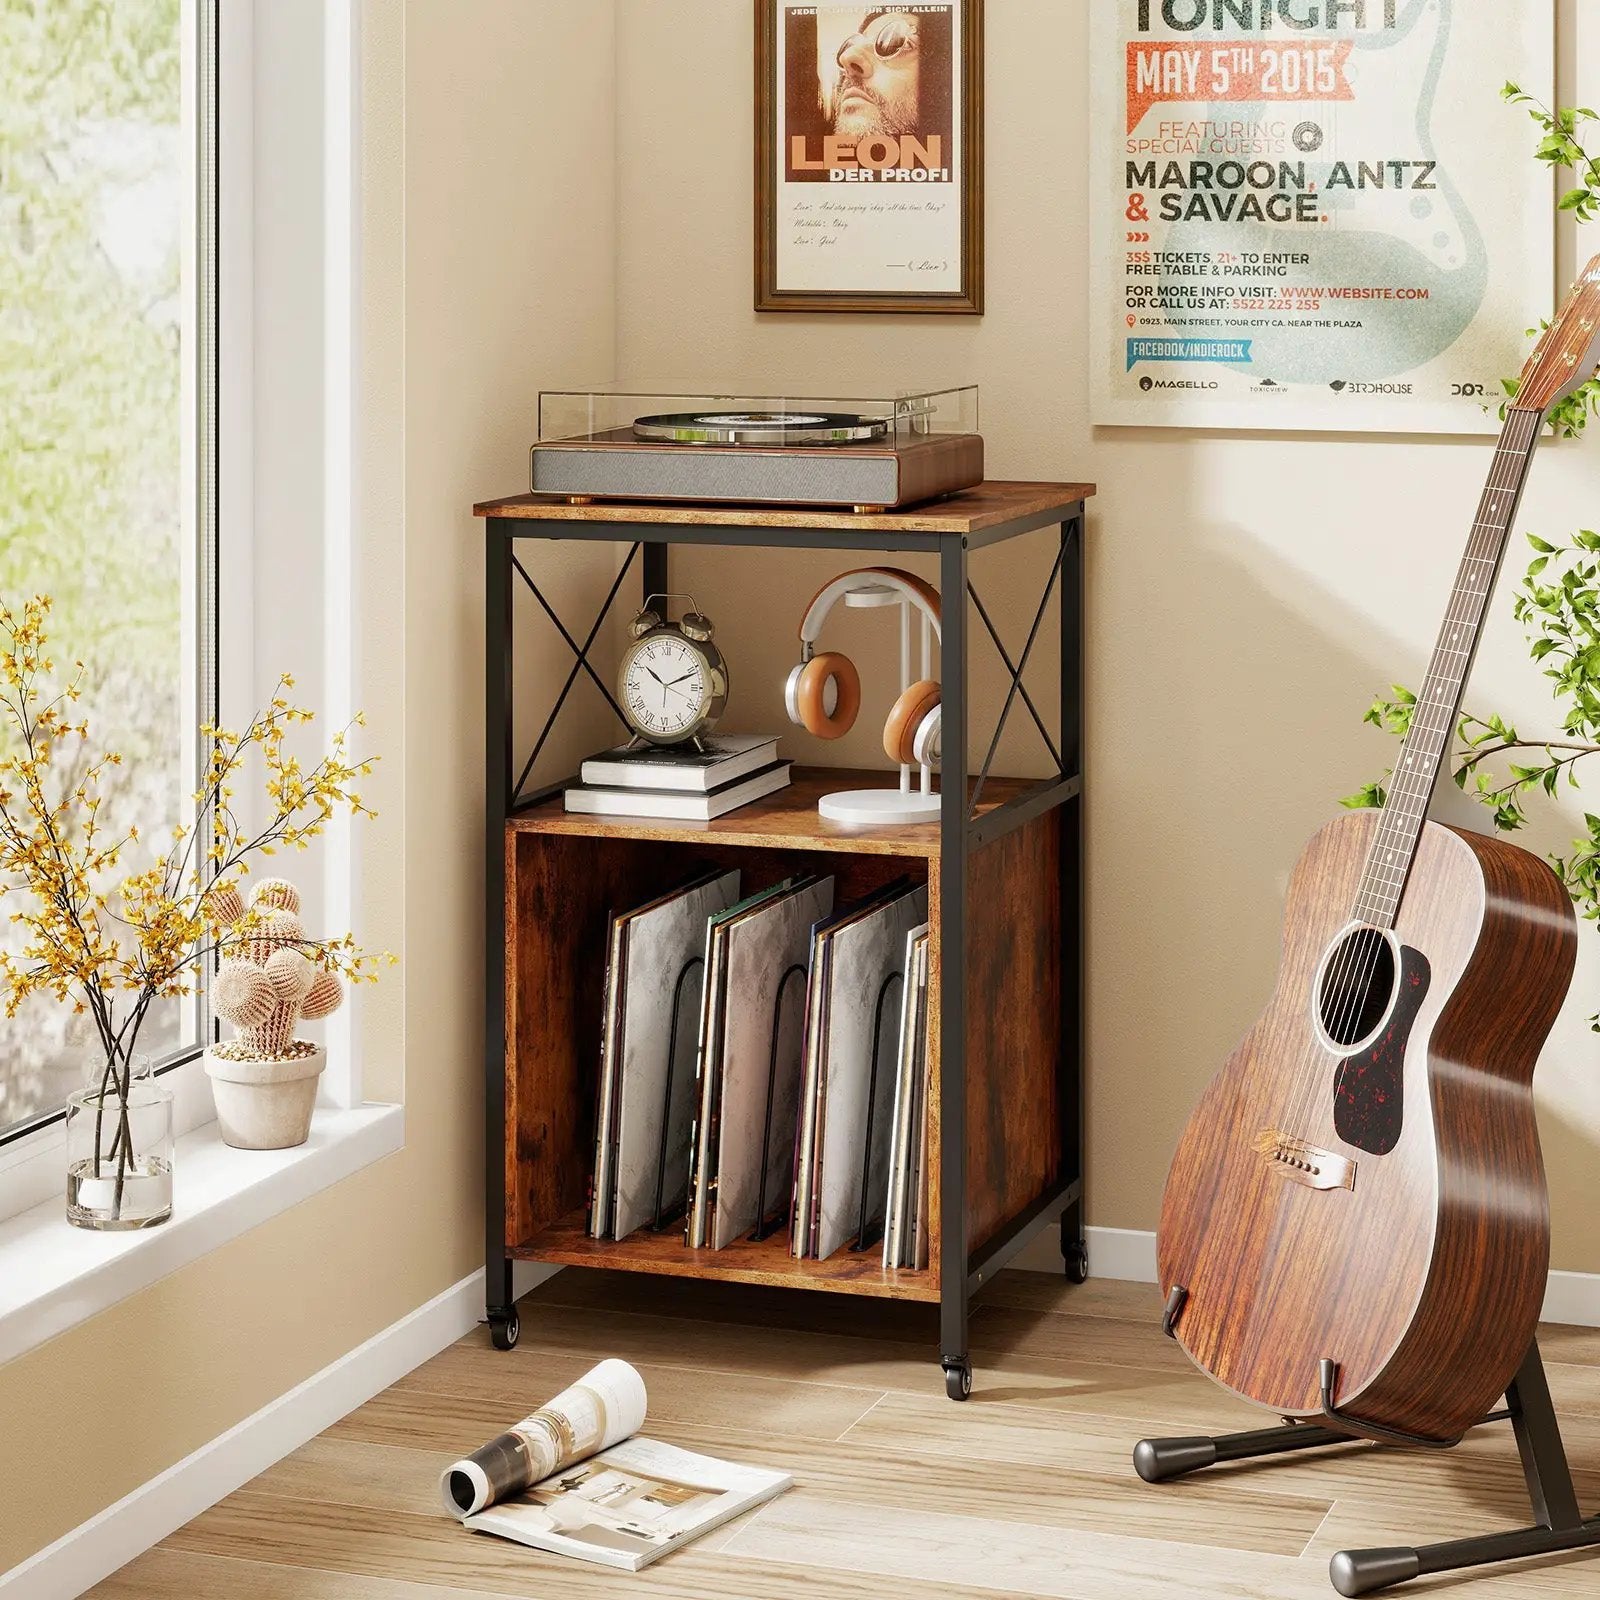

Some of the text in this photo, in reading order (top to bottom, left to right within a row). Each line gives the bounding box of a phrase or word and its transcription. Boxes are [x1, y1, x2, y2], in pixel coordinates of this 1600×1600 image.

[1137, 48, 1336, 93] MAY 5TH 2015
[1159, 121, 1286, 138] FEATURING
[791, 134, 942, 170] LEON
[1126, 138, 1286, 154] SPECIAL GUESTS
[829, 168, 948, 182] DER PROFI
[1125, 160, 1437, 193] MAROON, ANTZ
[1125, 192, 1329, 222] & SAVAGE.
[1126, 251, 1310, 264] 35$ TICKETS, 21+ TO ENTER
[1126, 265, 1287, 276] FREE TABLE & PARKING
[1126, 285, 1429, 300] FOR MORE INFO VISIT: WWW.WEBSITE.COM
[1126, 298, 1320, 310] OR CALL US AT: 5522 225 255
[1188, 319, 1223, 327] STREET,
[1250, 319, 1270, 327] CITY
[1133, 342, 1244, 358] FACEBOOK/INDIEROCK
[1154, 380, 1218, 389] MAGELLO
[1348, 382, 1413, 394] BIRDHOUSE
